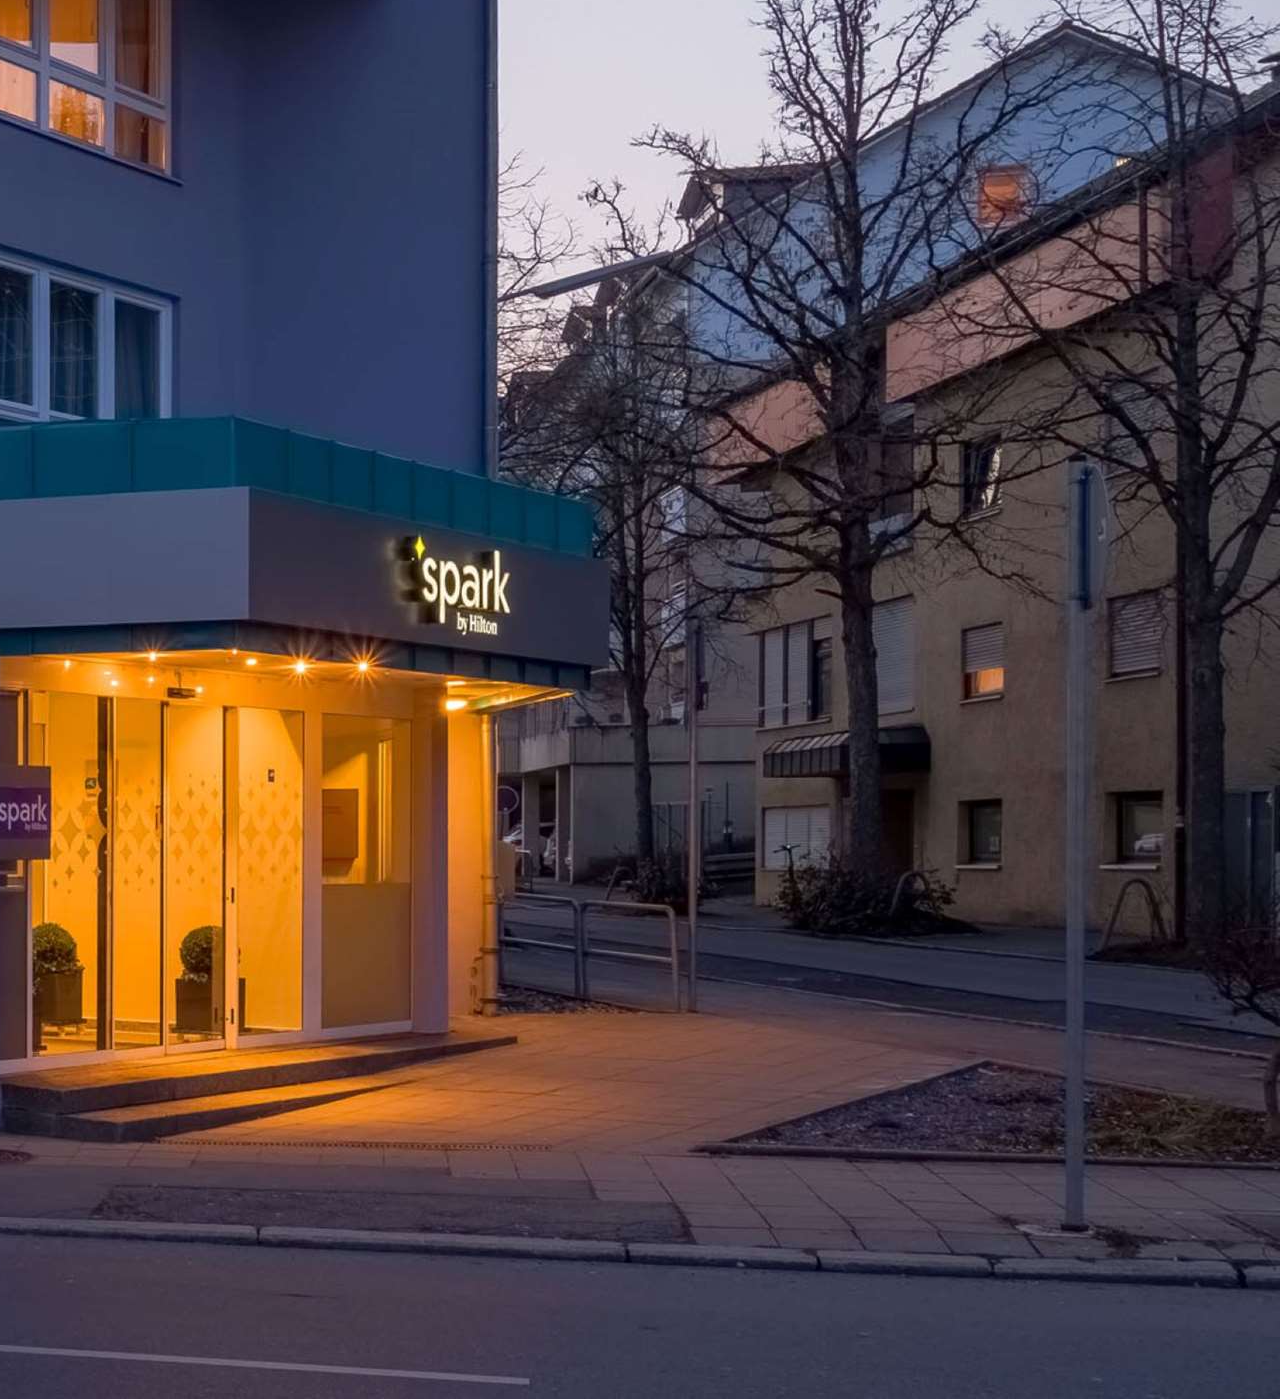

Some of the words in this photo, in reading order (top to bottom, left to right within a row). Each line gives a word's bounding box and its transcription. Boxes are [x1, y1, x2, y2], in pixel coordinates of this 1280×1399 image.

[422, 550, 510, 624] spark
[456, 611, 468, 635] by
[469, 613, 498, 635] Hilton
